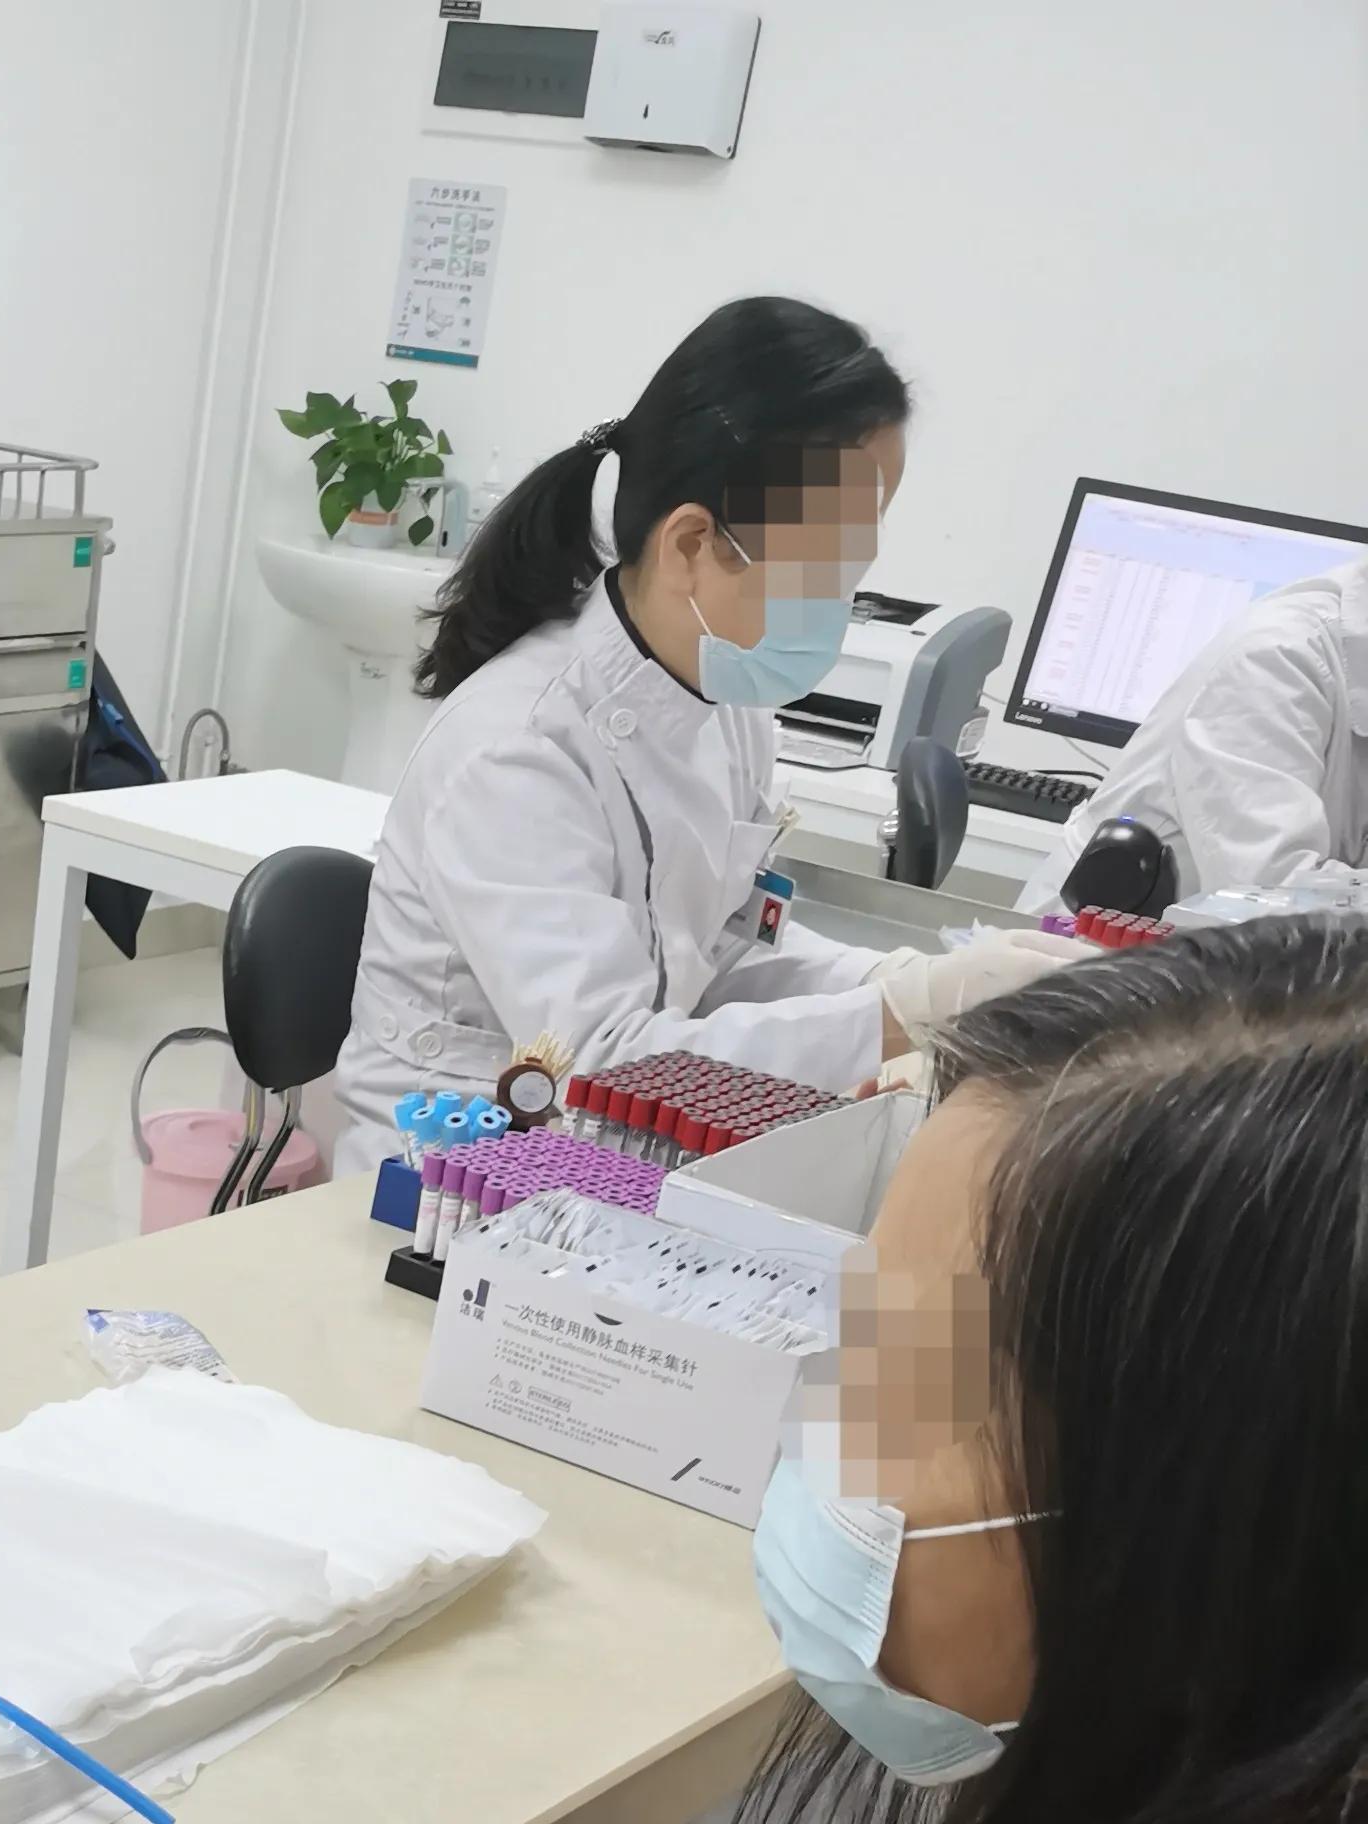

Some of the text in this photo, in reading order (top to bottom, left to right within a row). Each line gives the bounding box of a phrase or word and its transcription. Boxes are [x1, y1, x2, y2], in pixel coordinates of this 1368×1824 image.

[504, 1303, 699, 1377] 一次性使用静脉血样采集针
